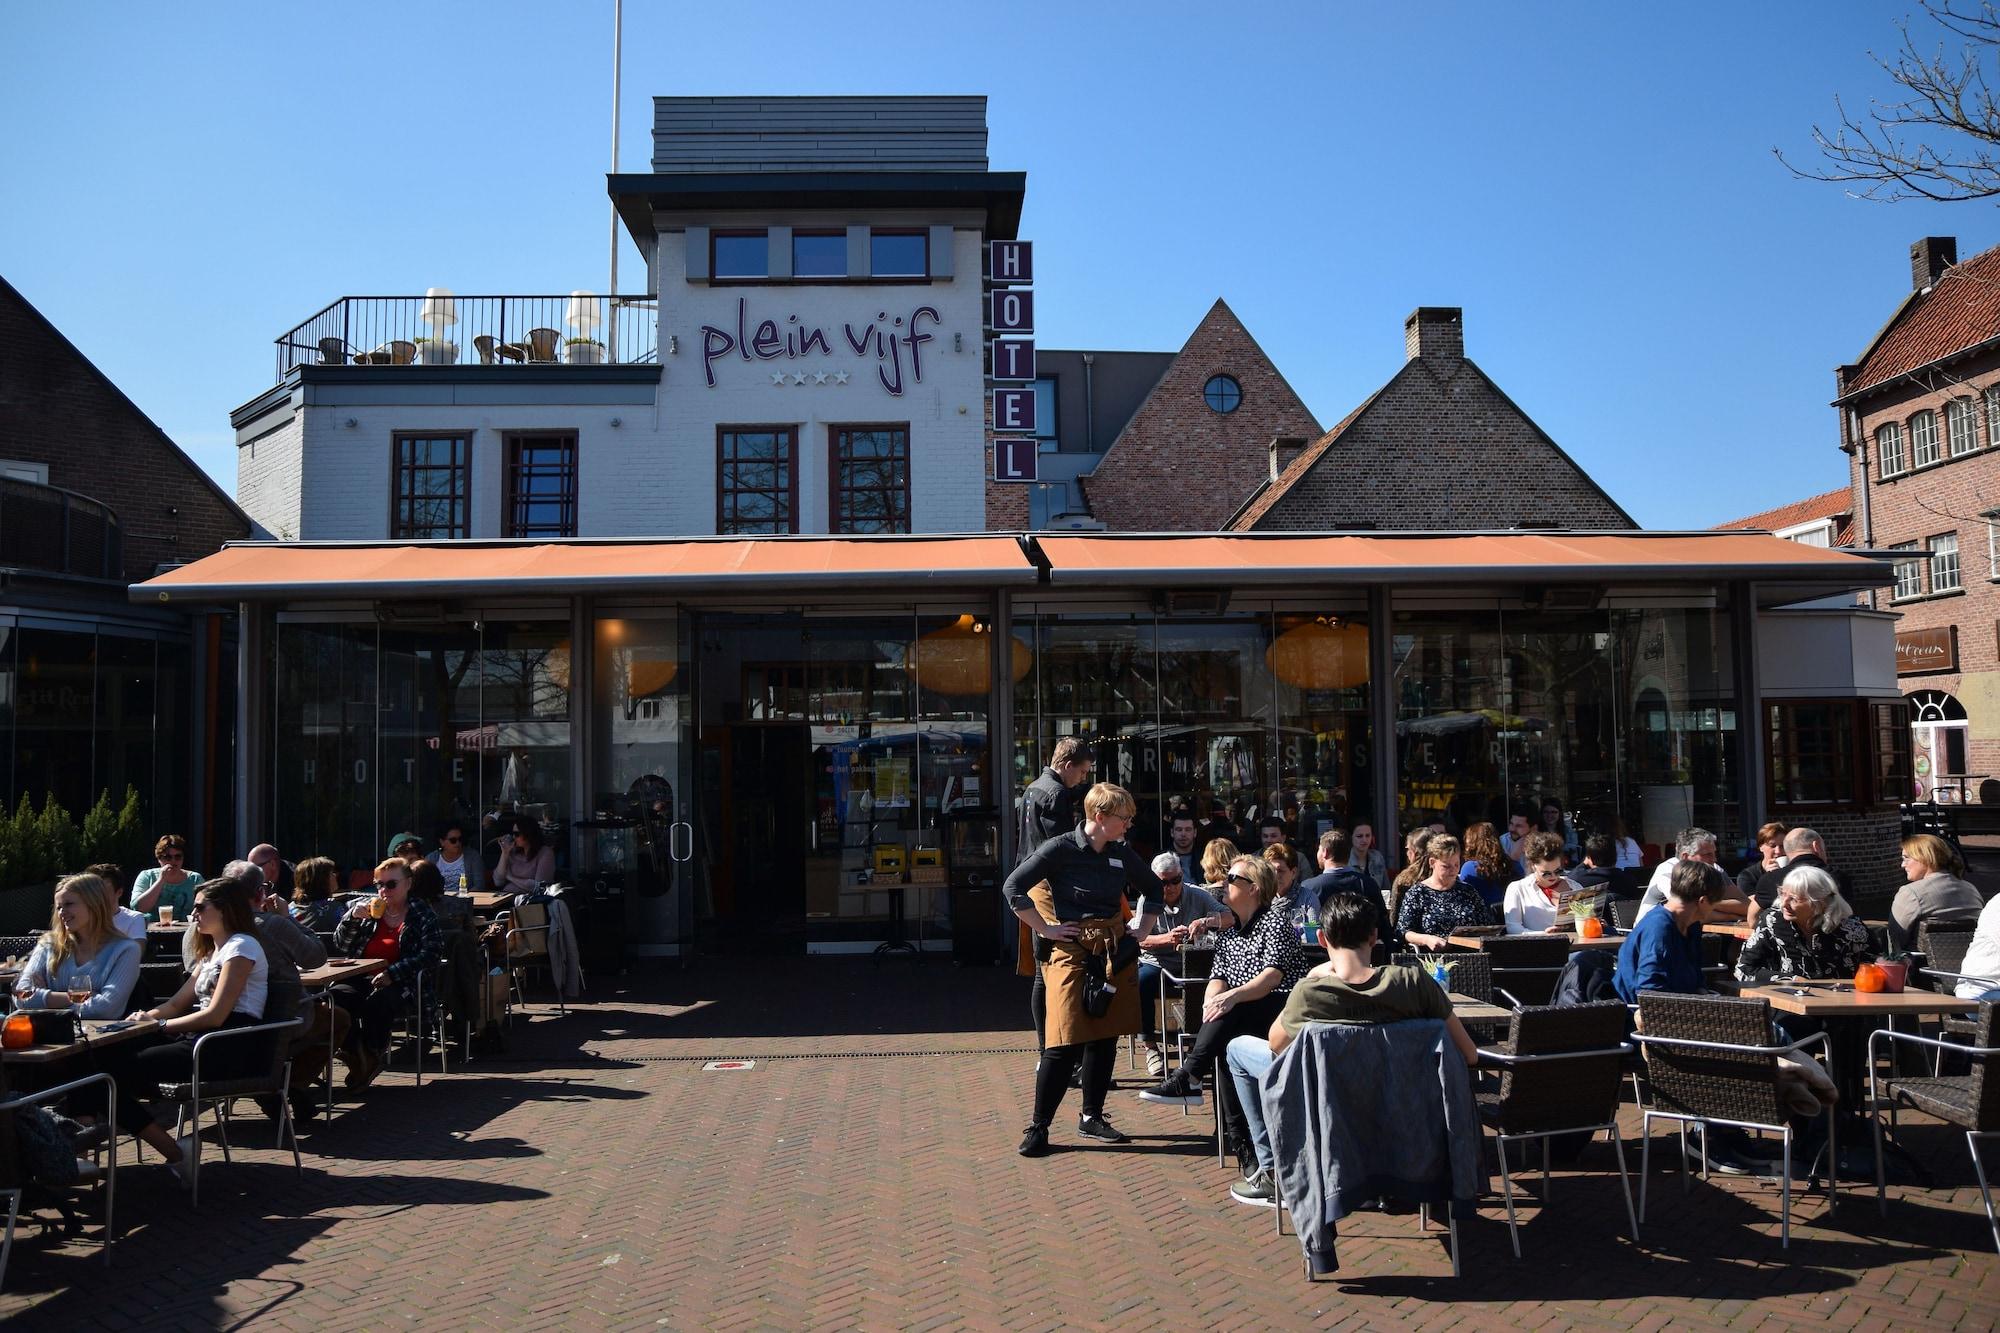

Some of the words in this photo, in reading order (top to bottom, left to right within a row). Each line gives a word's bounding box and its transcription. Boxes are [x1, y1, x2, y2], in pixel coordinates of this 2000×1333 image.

[701, 296, 832, 388] plein
[844, 306, 941, 396] vijf
[1003, 245, 1023, 477] HOTEL
